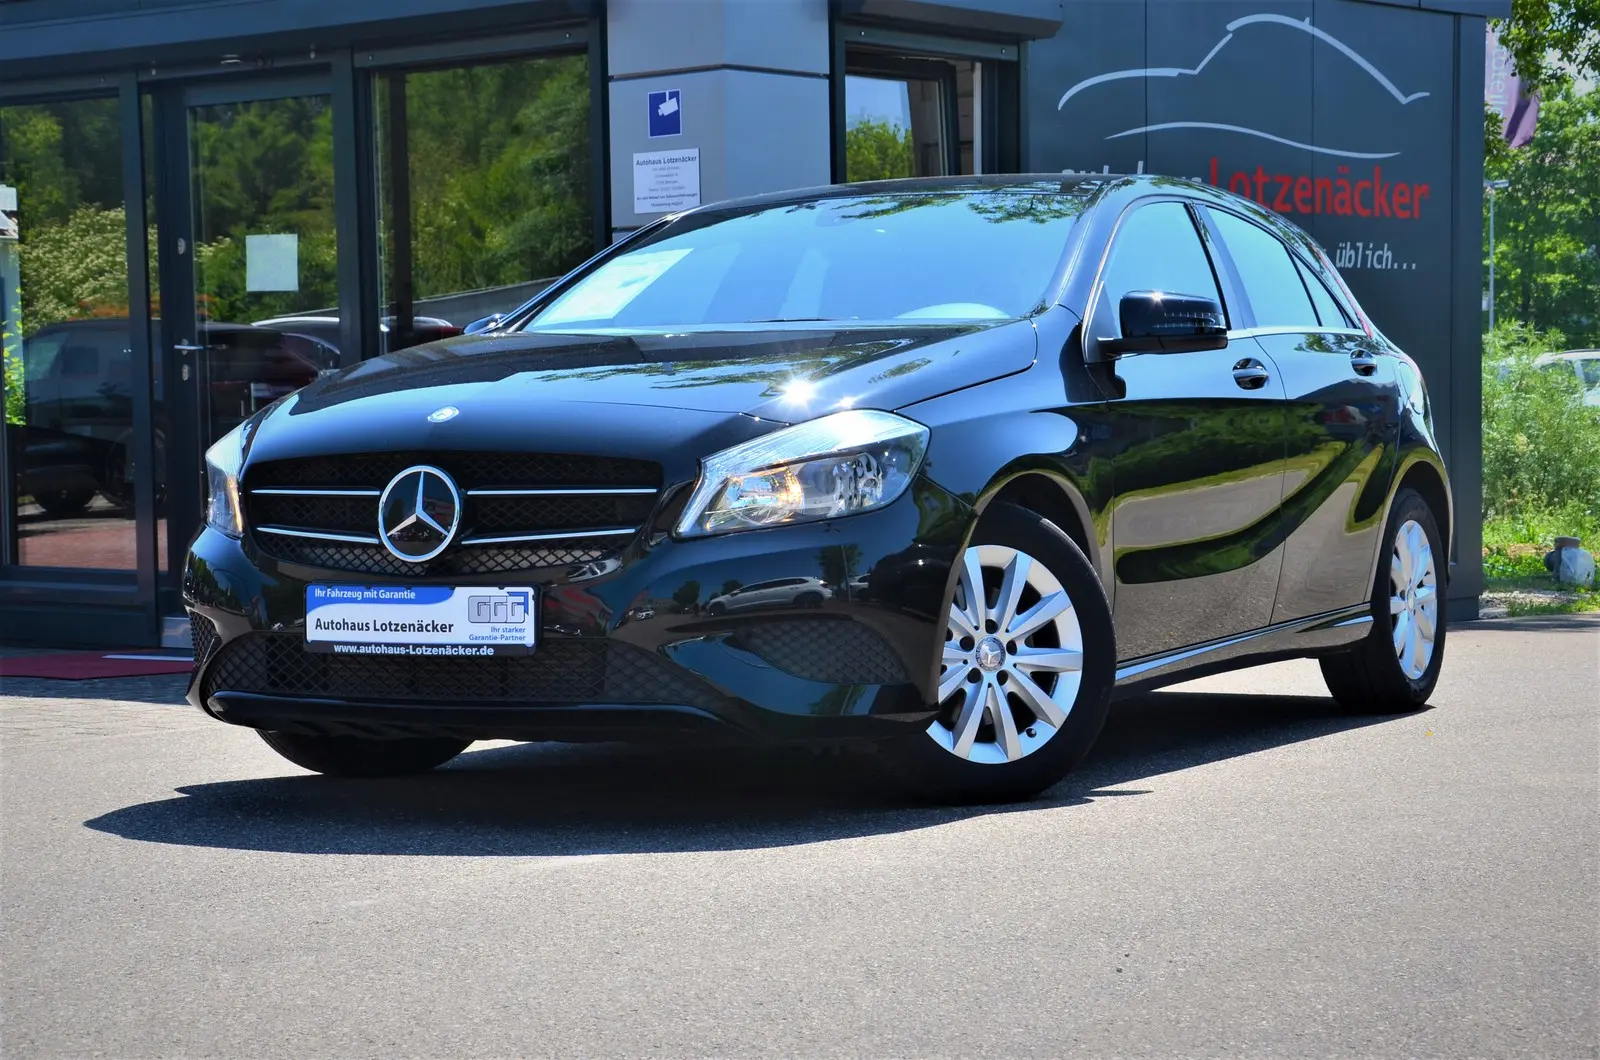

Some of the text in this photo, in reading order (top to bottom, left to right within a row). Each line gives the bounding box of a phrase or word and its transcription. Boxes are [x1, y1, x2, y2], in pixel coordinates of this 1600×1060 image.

[663, 156, 697, 164] Lotzenäcker
[315, 588, 416, 600] Ihr Fahrzeug mit Garantie
[315, 618, 454, 633] Autohaus Lotzenäcker
[334, 643, 495, 656] www.autohaus-Lotzenäcker.de
